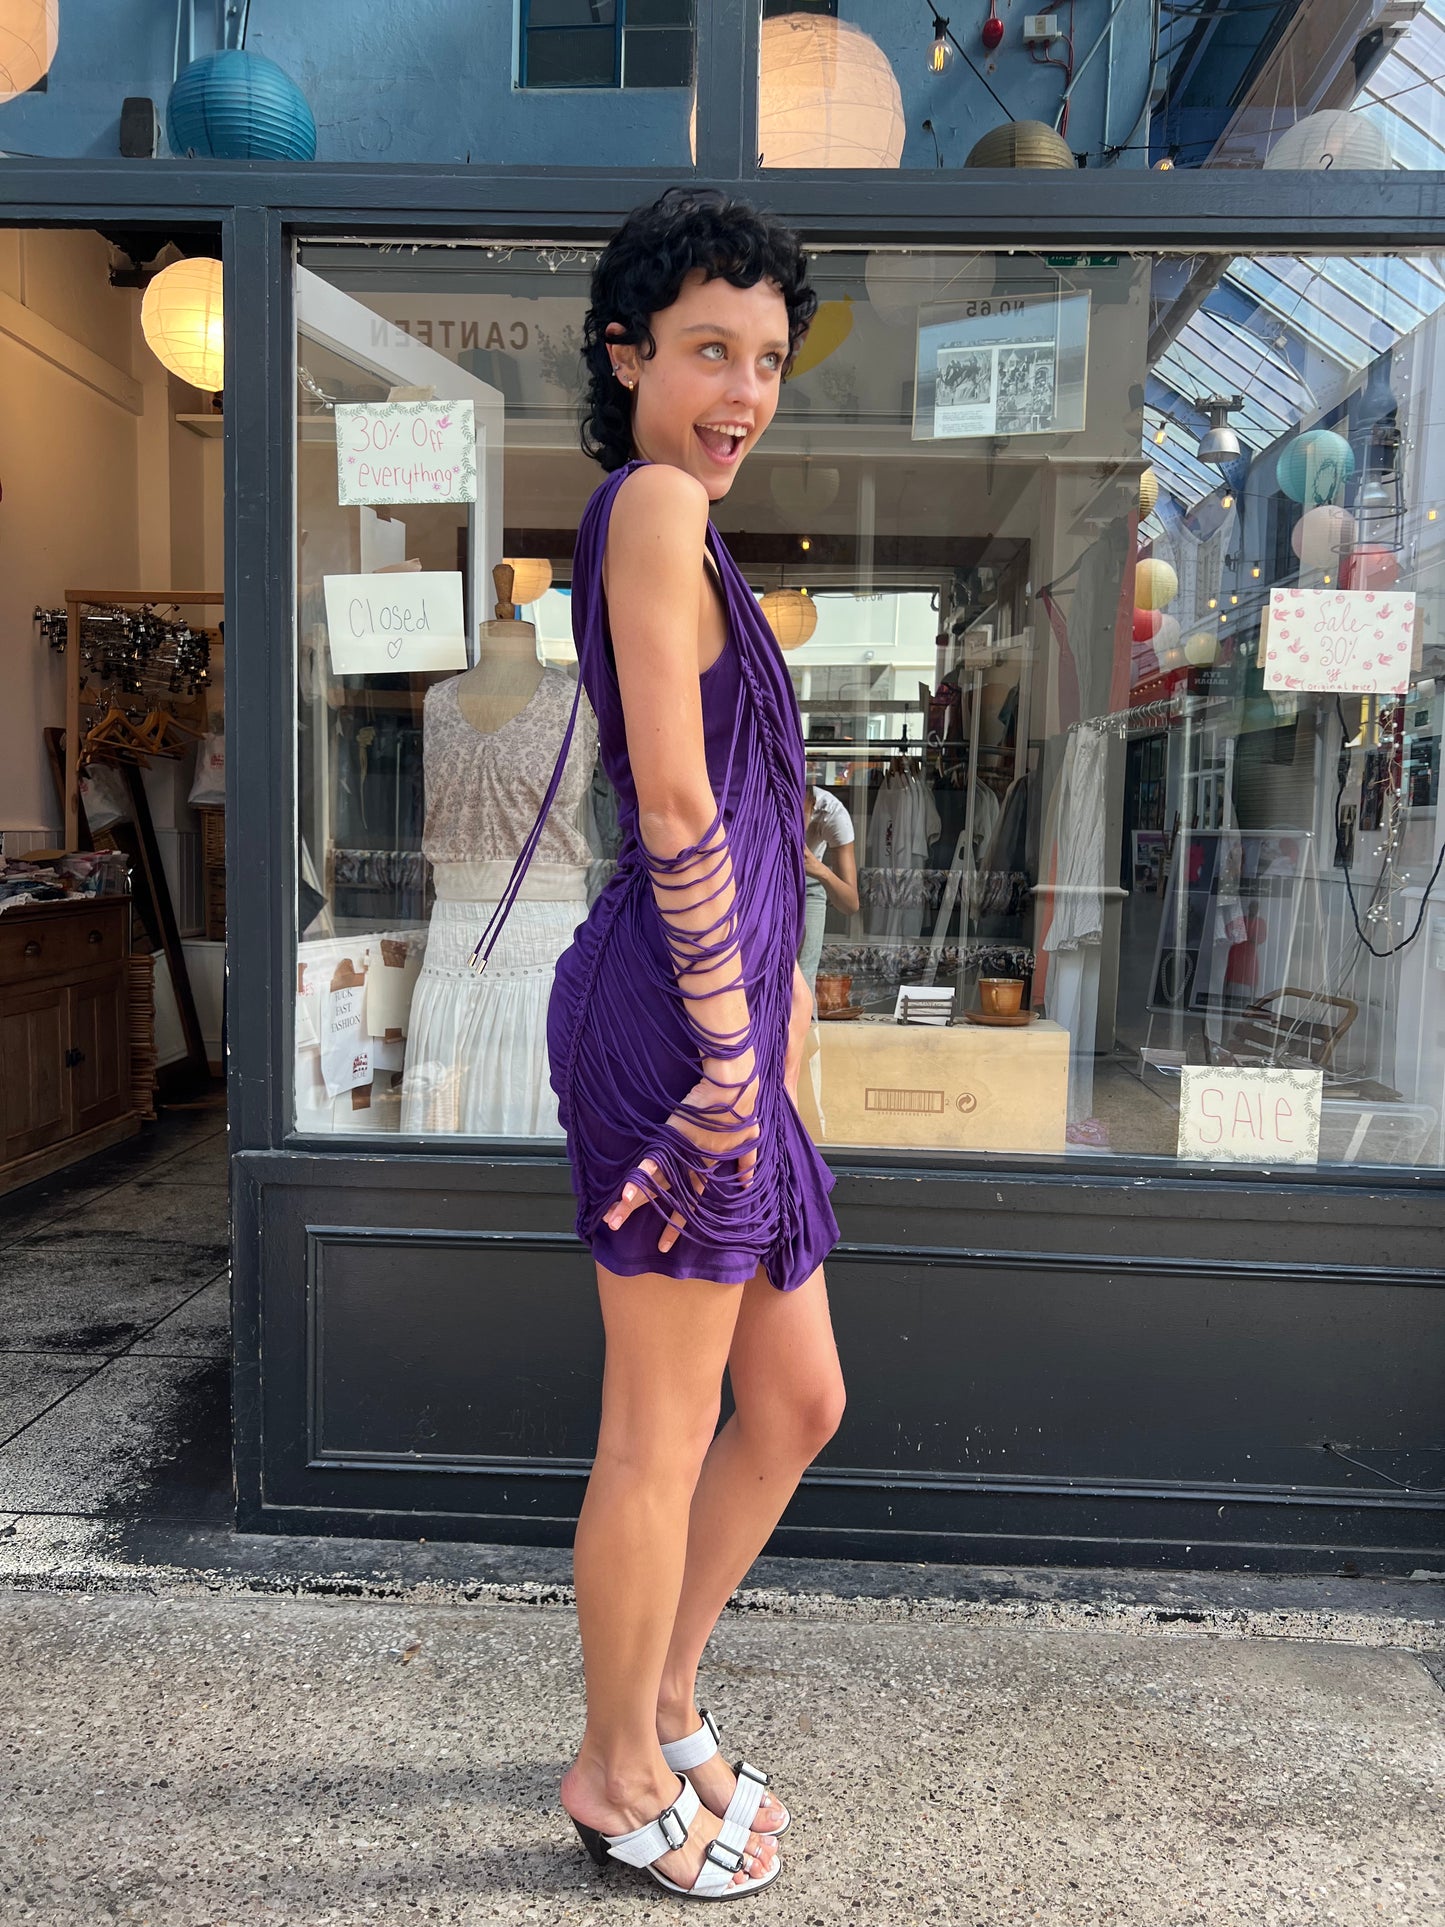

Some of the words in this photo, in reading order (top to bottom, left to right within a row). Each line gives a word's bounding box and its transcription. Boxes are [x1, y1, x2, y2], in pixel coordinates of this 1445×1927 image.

[351, 415, 401, 452] 30%
[358, 462, 453, 496] everything
[349, 598, 430, 638] Closed
[1313, 600, 1373, 633] Sale
[1319, 635, 1359, 667] 30%
[1325, 668, 1342, 683] off
[331, 1014, 361, 1033] FASHION
[335, 1002, 352, 1017] FAST
